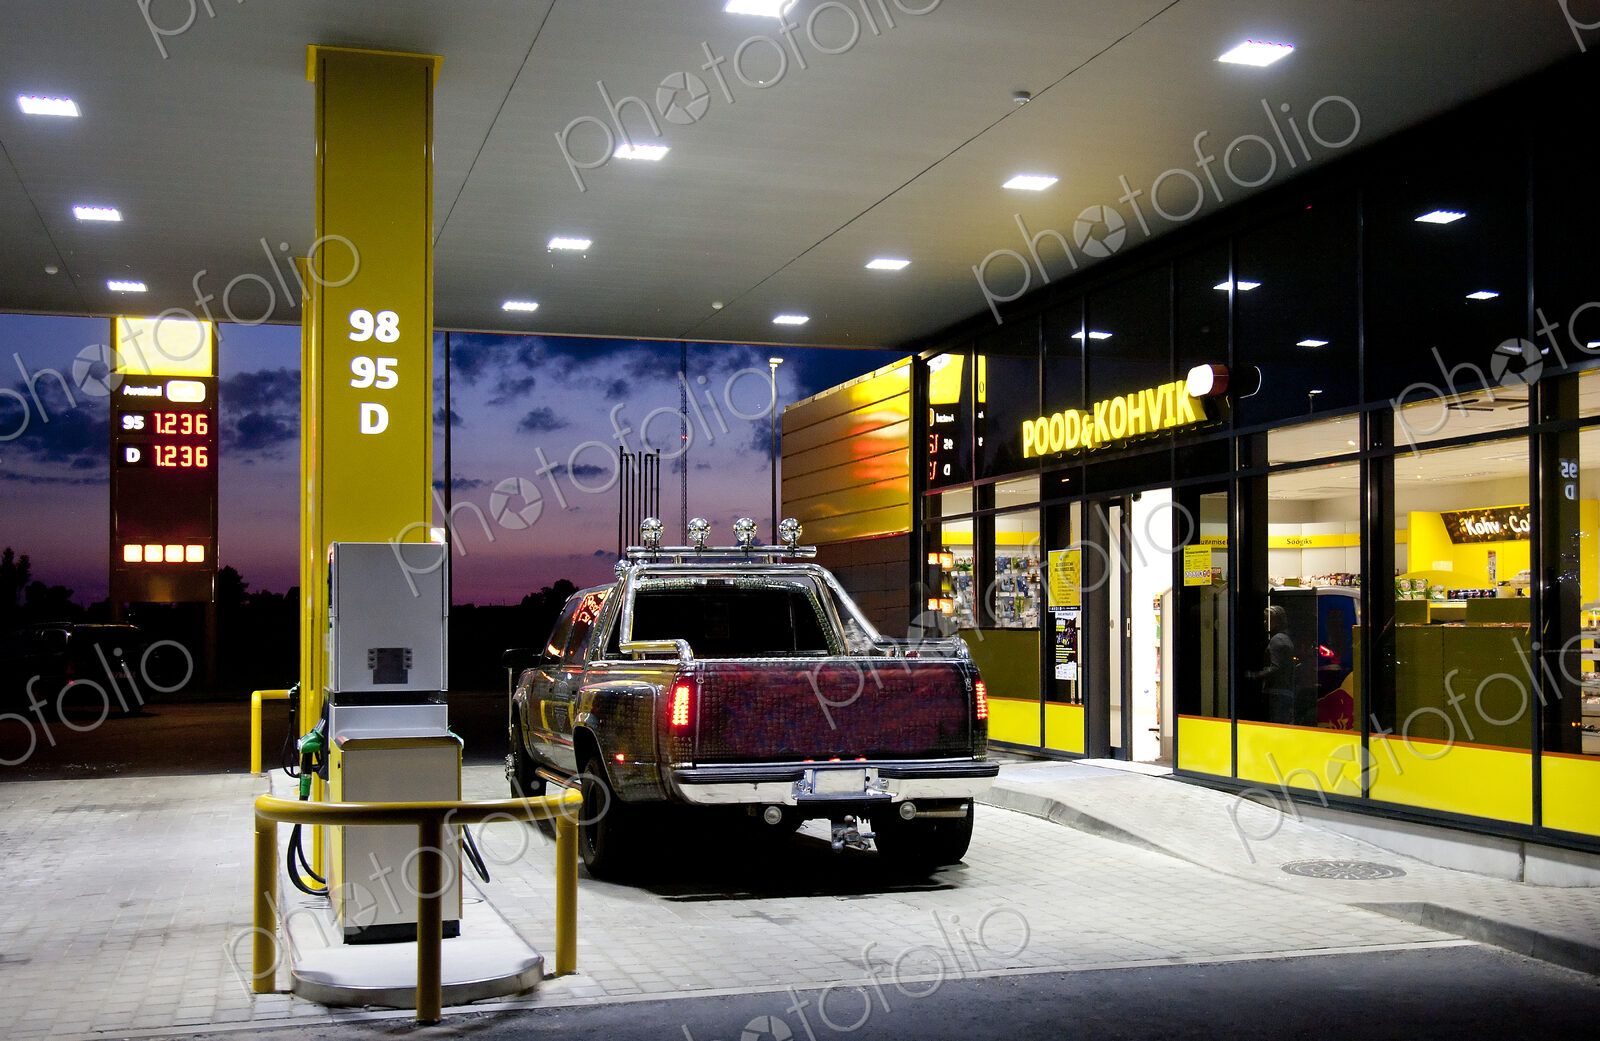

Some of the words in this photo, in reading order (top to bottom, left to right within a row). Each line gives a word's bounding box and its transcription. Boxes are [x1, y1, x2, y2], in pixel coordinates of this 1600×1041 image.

[348, 309, 400, 343] 98
[350, 356, 399, 389] 95
[122, 415, 145, 430] 95
[154, 412, 208, 435] 1.236
[360, 402, 389, 434] D
[1022, 379, 1198, 459] POOD&KOHVIK
[125, 447, 141, 463] D
[154, 445, 208, 467] 1.236
[1464, 516, 1500, 536] Kohv
